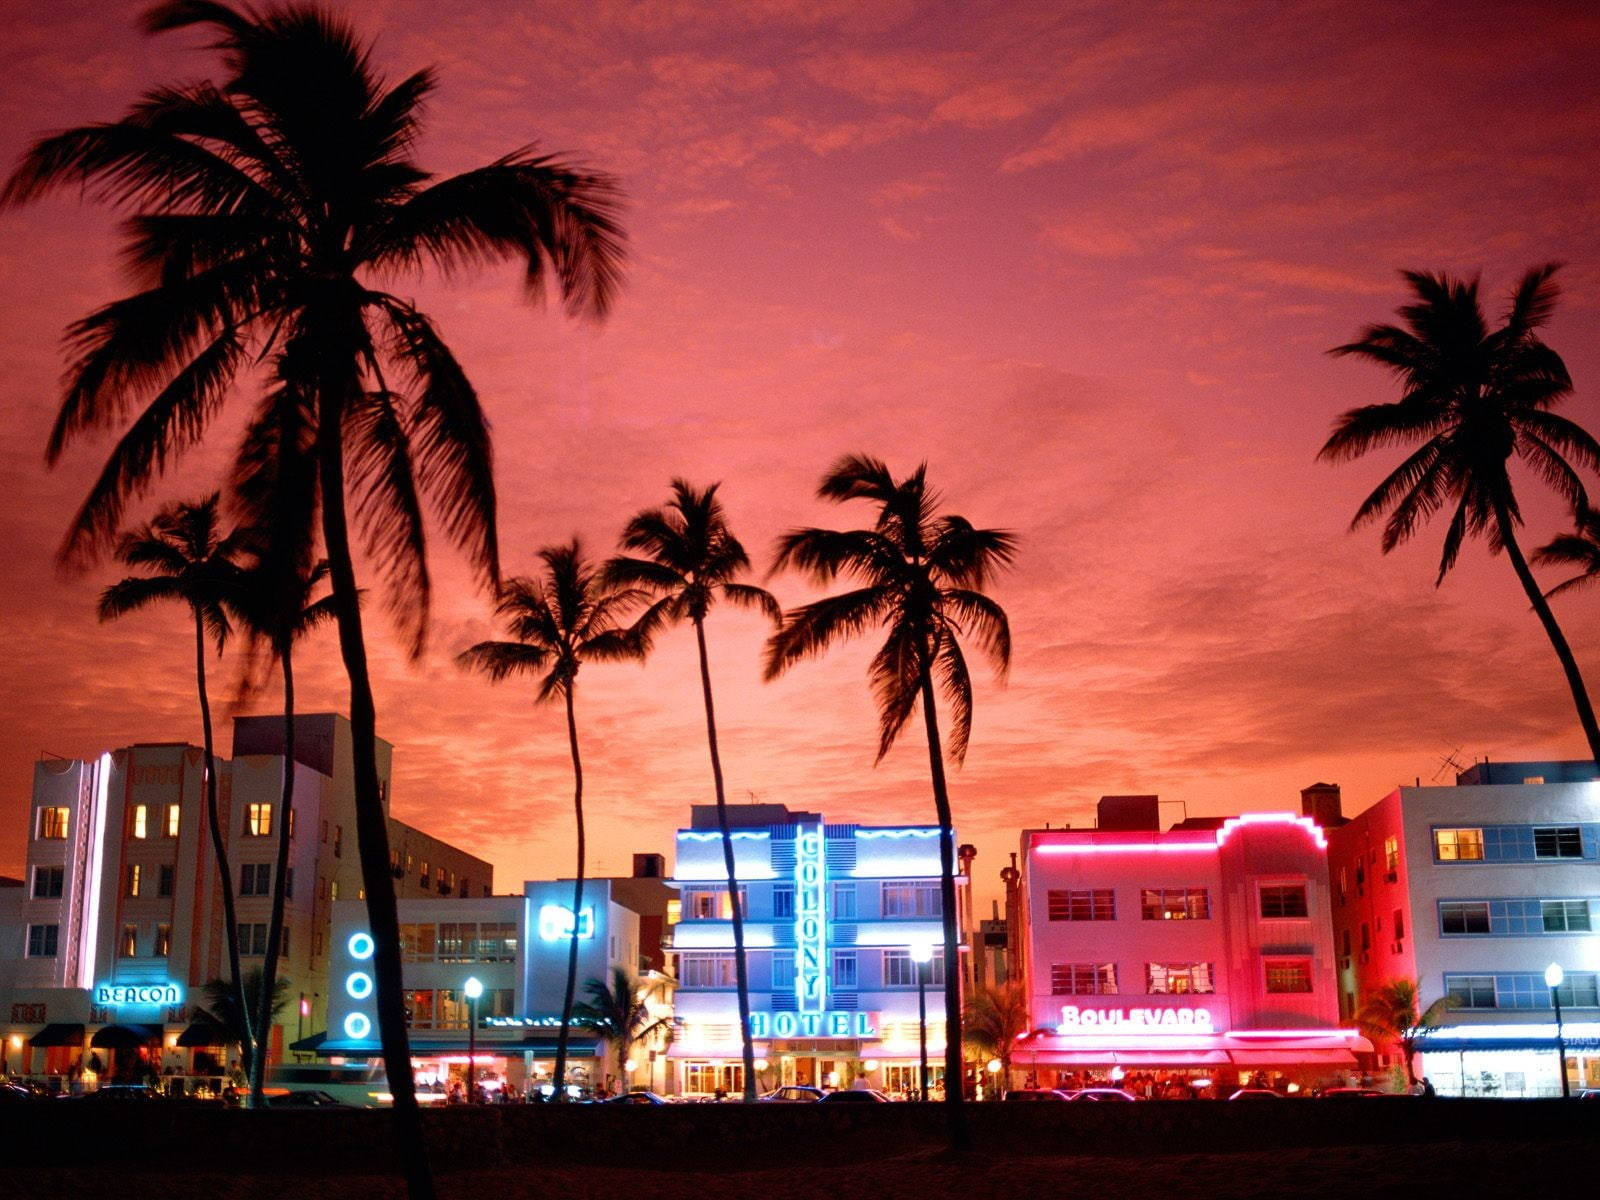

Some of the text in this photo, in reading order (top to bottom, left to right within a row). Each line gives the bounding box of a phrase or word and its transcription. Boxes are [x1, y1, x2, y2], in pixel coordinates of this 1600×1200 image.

[801, 832, 820, 997] COLONY
[98, 987, 177, 1002] BEACON
[749, 1012, 875, 1038] HOTEL
[1061, 1006, 1212, 1028] BOULEVARD
